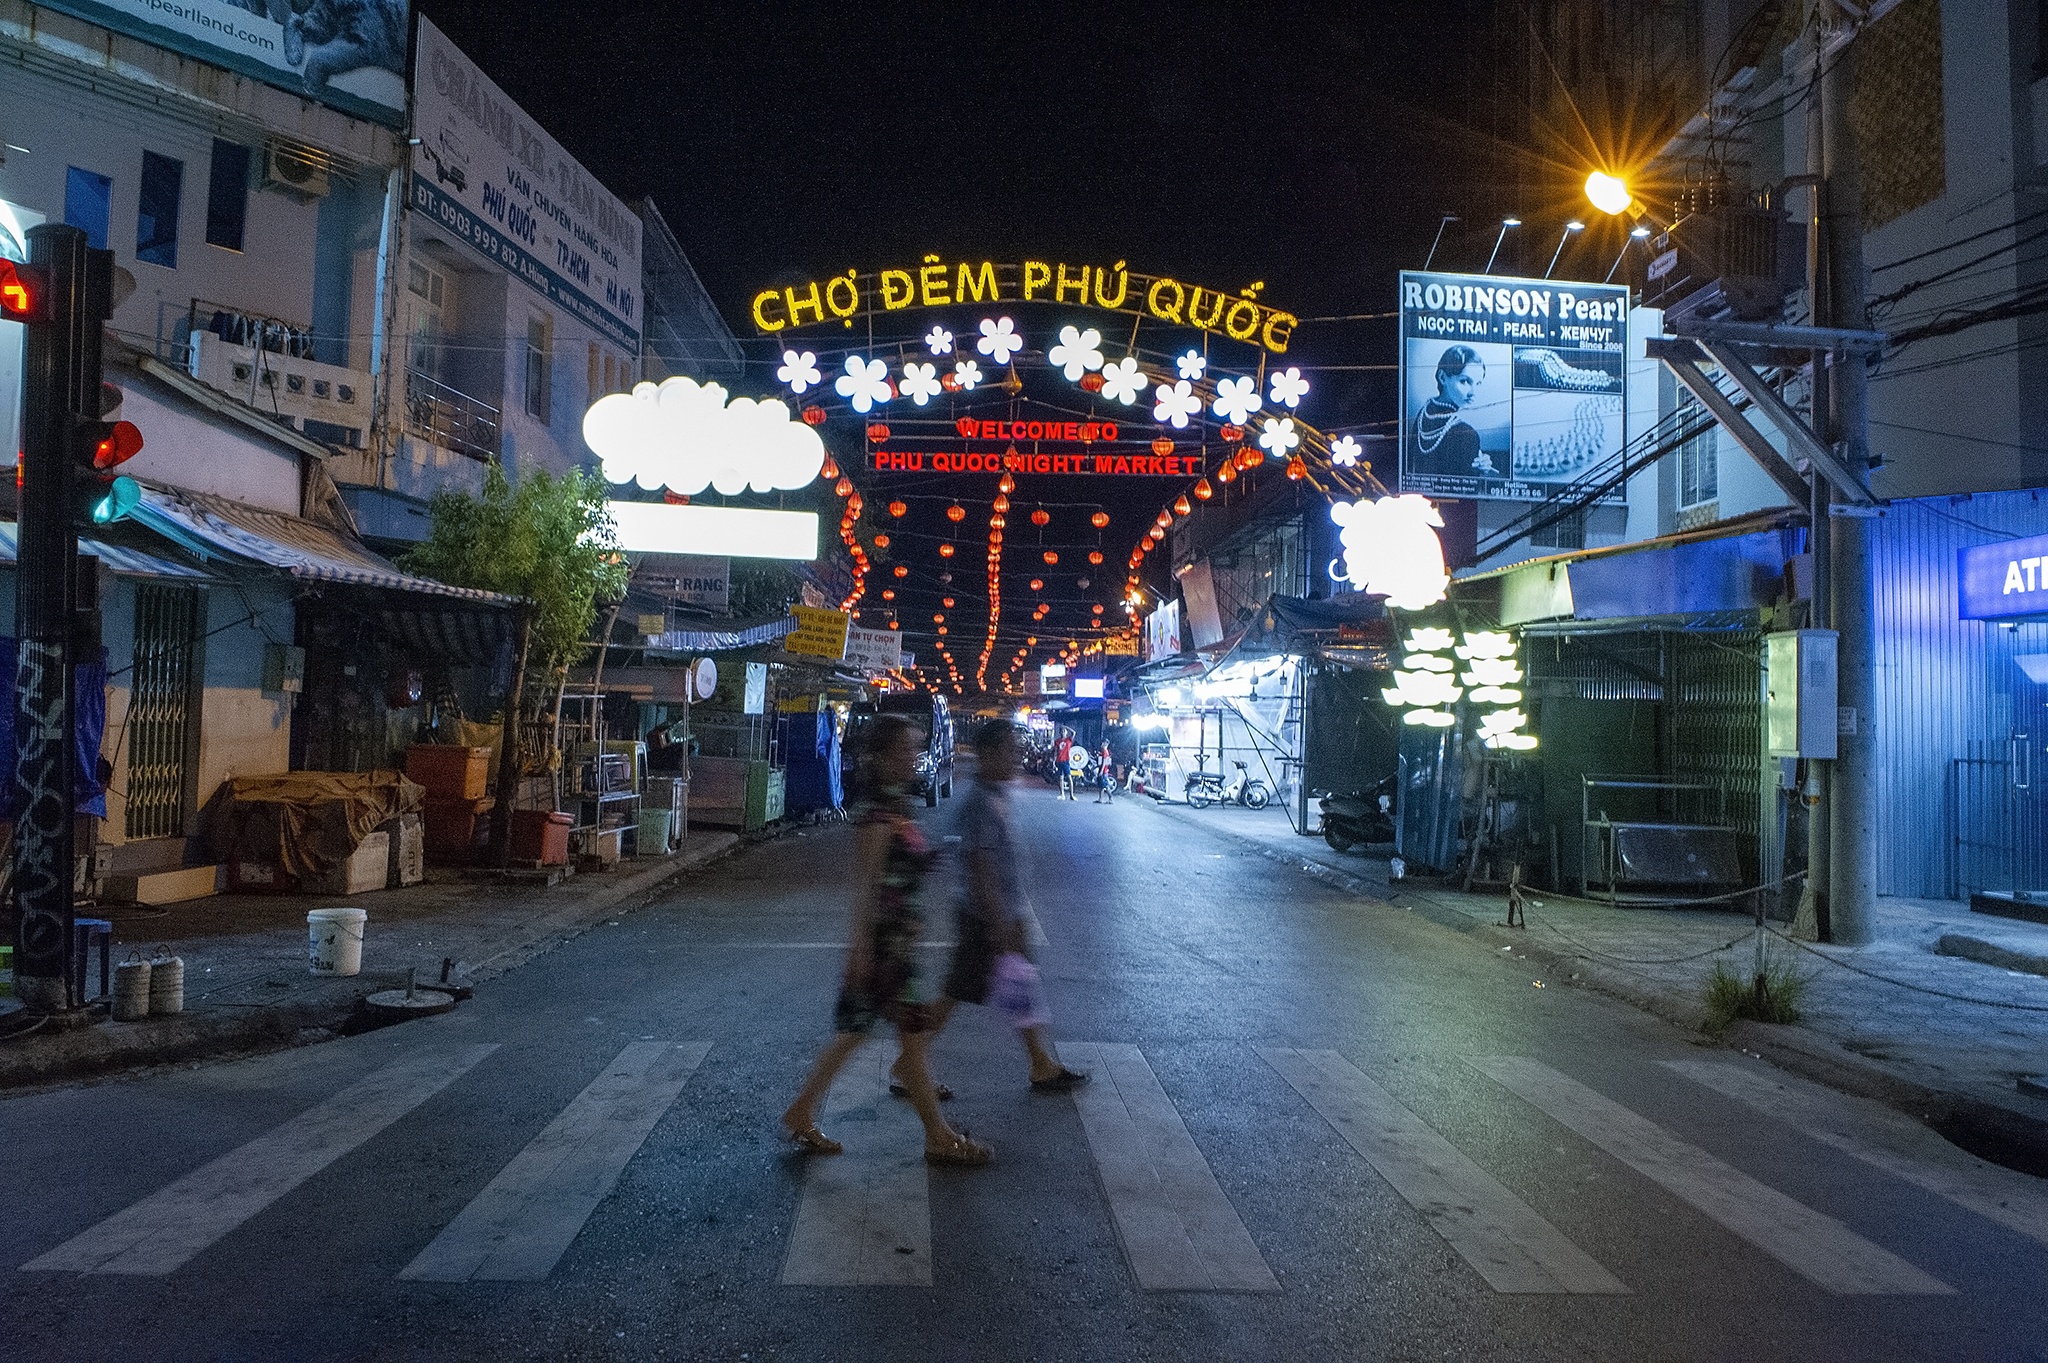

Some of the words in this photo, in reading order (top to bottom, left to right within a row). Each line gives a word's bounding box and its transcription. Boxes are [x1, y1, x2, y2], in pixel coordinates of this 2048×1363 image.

[517, 124, 546, 182] XE
[418, 185, 437, 213] ĐT:
[441, 201, 470, 236] 0903
[474, 224, 498, 254] 999
[502, 244, 517, 269] 812
[507, 166, 530, 200] VẬN
[574, 222, 598, 254] HÀNG
[482, 181, 506, 222] PHÚ
[508, 202, 537, 246] QUỐC
[557, 238, 589, 287] TP.HCM
[606, 276, 617, 308] HÀ
[619, 287, 634, 320] NỘI
[753, 268, 858, 331] CHỢ
[879, 253, 999, 311] ĐÊM
[1024, 259, 1128, 309] PHÚ
[1148, 281, 1299, 353] QUỐC
[1404, 281, 1551, 318] ROBINSON
[1558, 292, 1626, 322] Pearl
[1418, 316, 1455, 335] NGỌC
[1458, 318, 1487, 336] TRAI
[1503, 322, 1545, 339] PEARL
[1560, 325, 1613, 342] ЖЕМЧУГ
[959, 420, 1080, 440] WELCOME
[1087, 421, 1119, 441] TO
[875, 452, 923, 471] PHU
[932, 452, 1000, 473] QUOC
[1010, 454, 1085, 473] NIGHT
[1095, 456, 1197, 475] MARKET
[683, 577, 724, 592] RANG
[2002, 555, 2048, 595] AT
